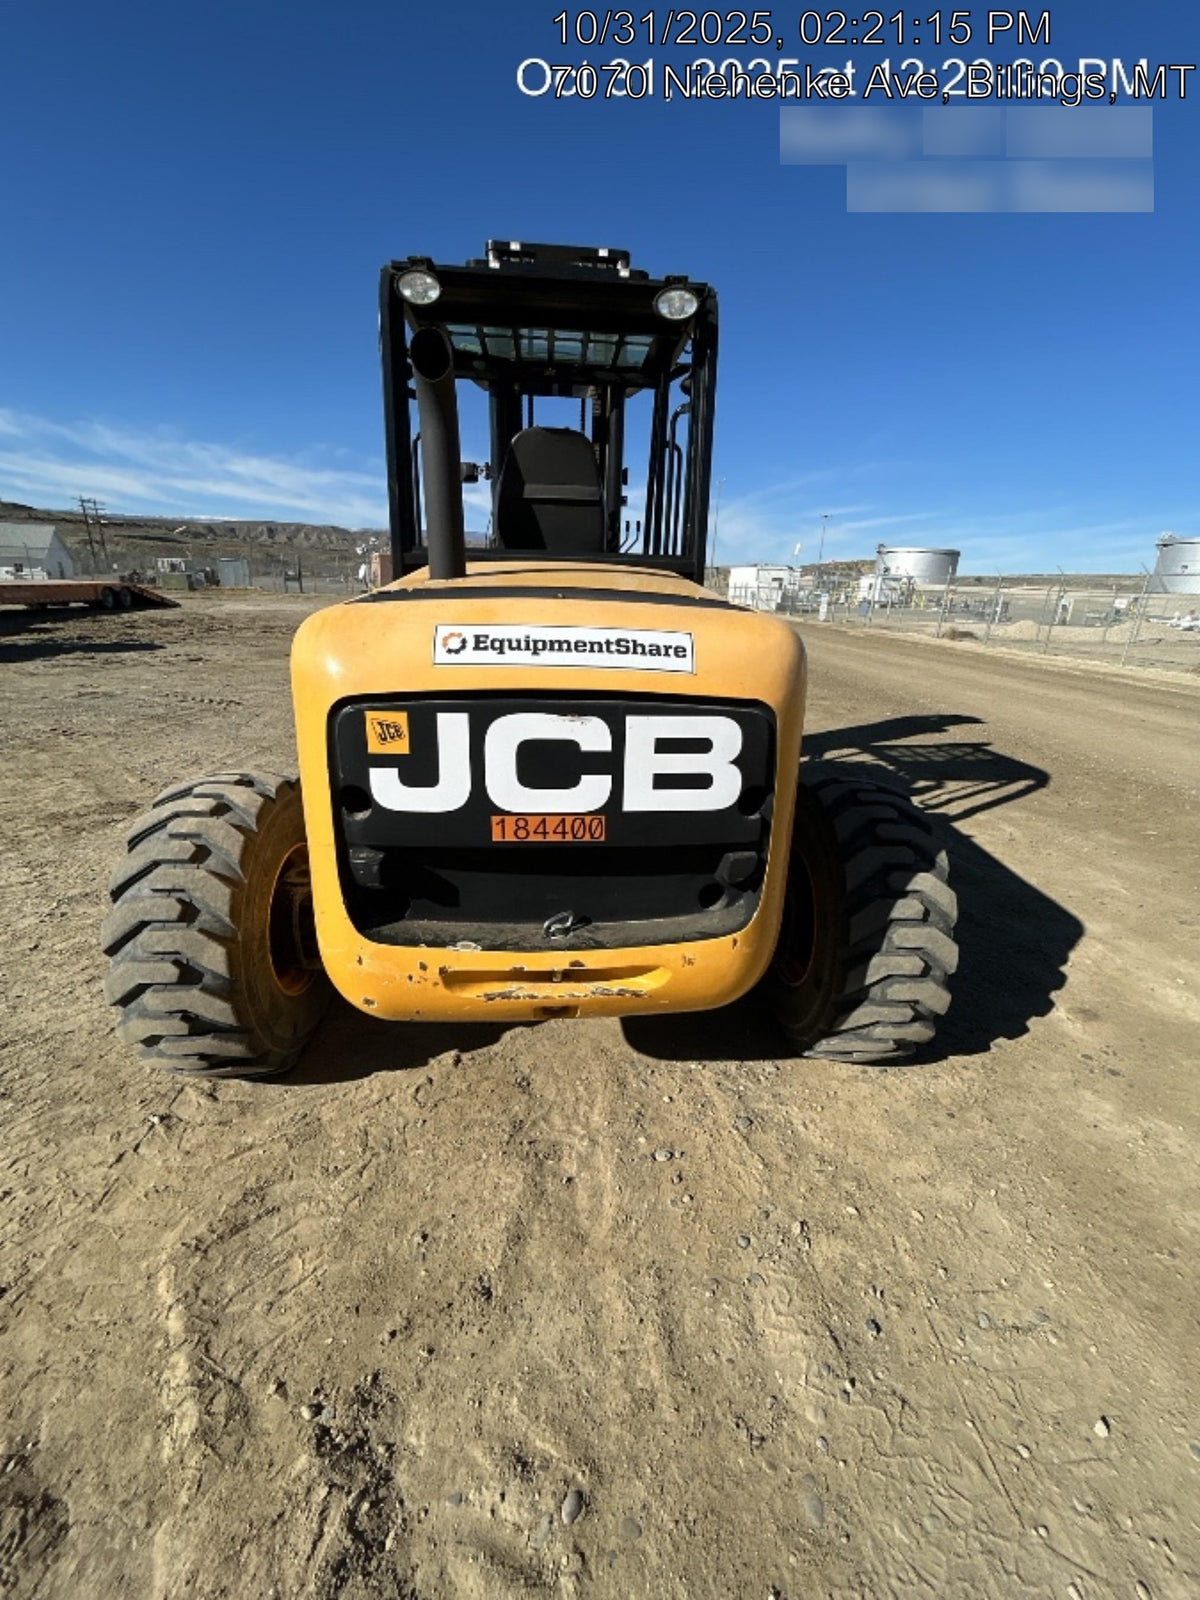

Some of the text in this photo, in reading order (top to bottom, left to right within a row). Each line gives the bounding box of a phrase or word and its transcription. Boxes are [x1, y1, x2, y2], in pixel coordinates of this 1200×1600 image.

[471, 633, 688, 660] EquipmentShare
[376, 720, 404, 742] JCB
[368, 712, 743, 813] JCB
[493, 816, 605, 841] 184400
